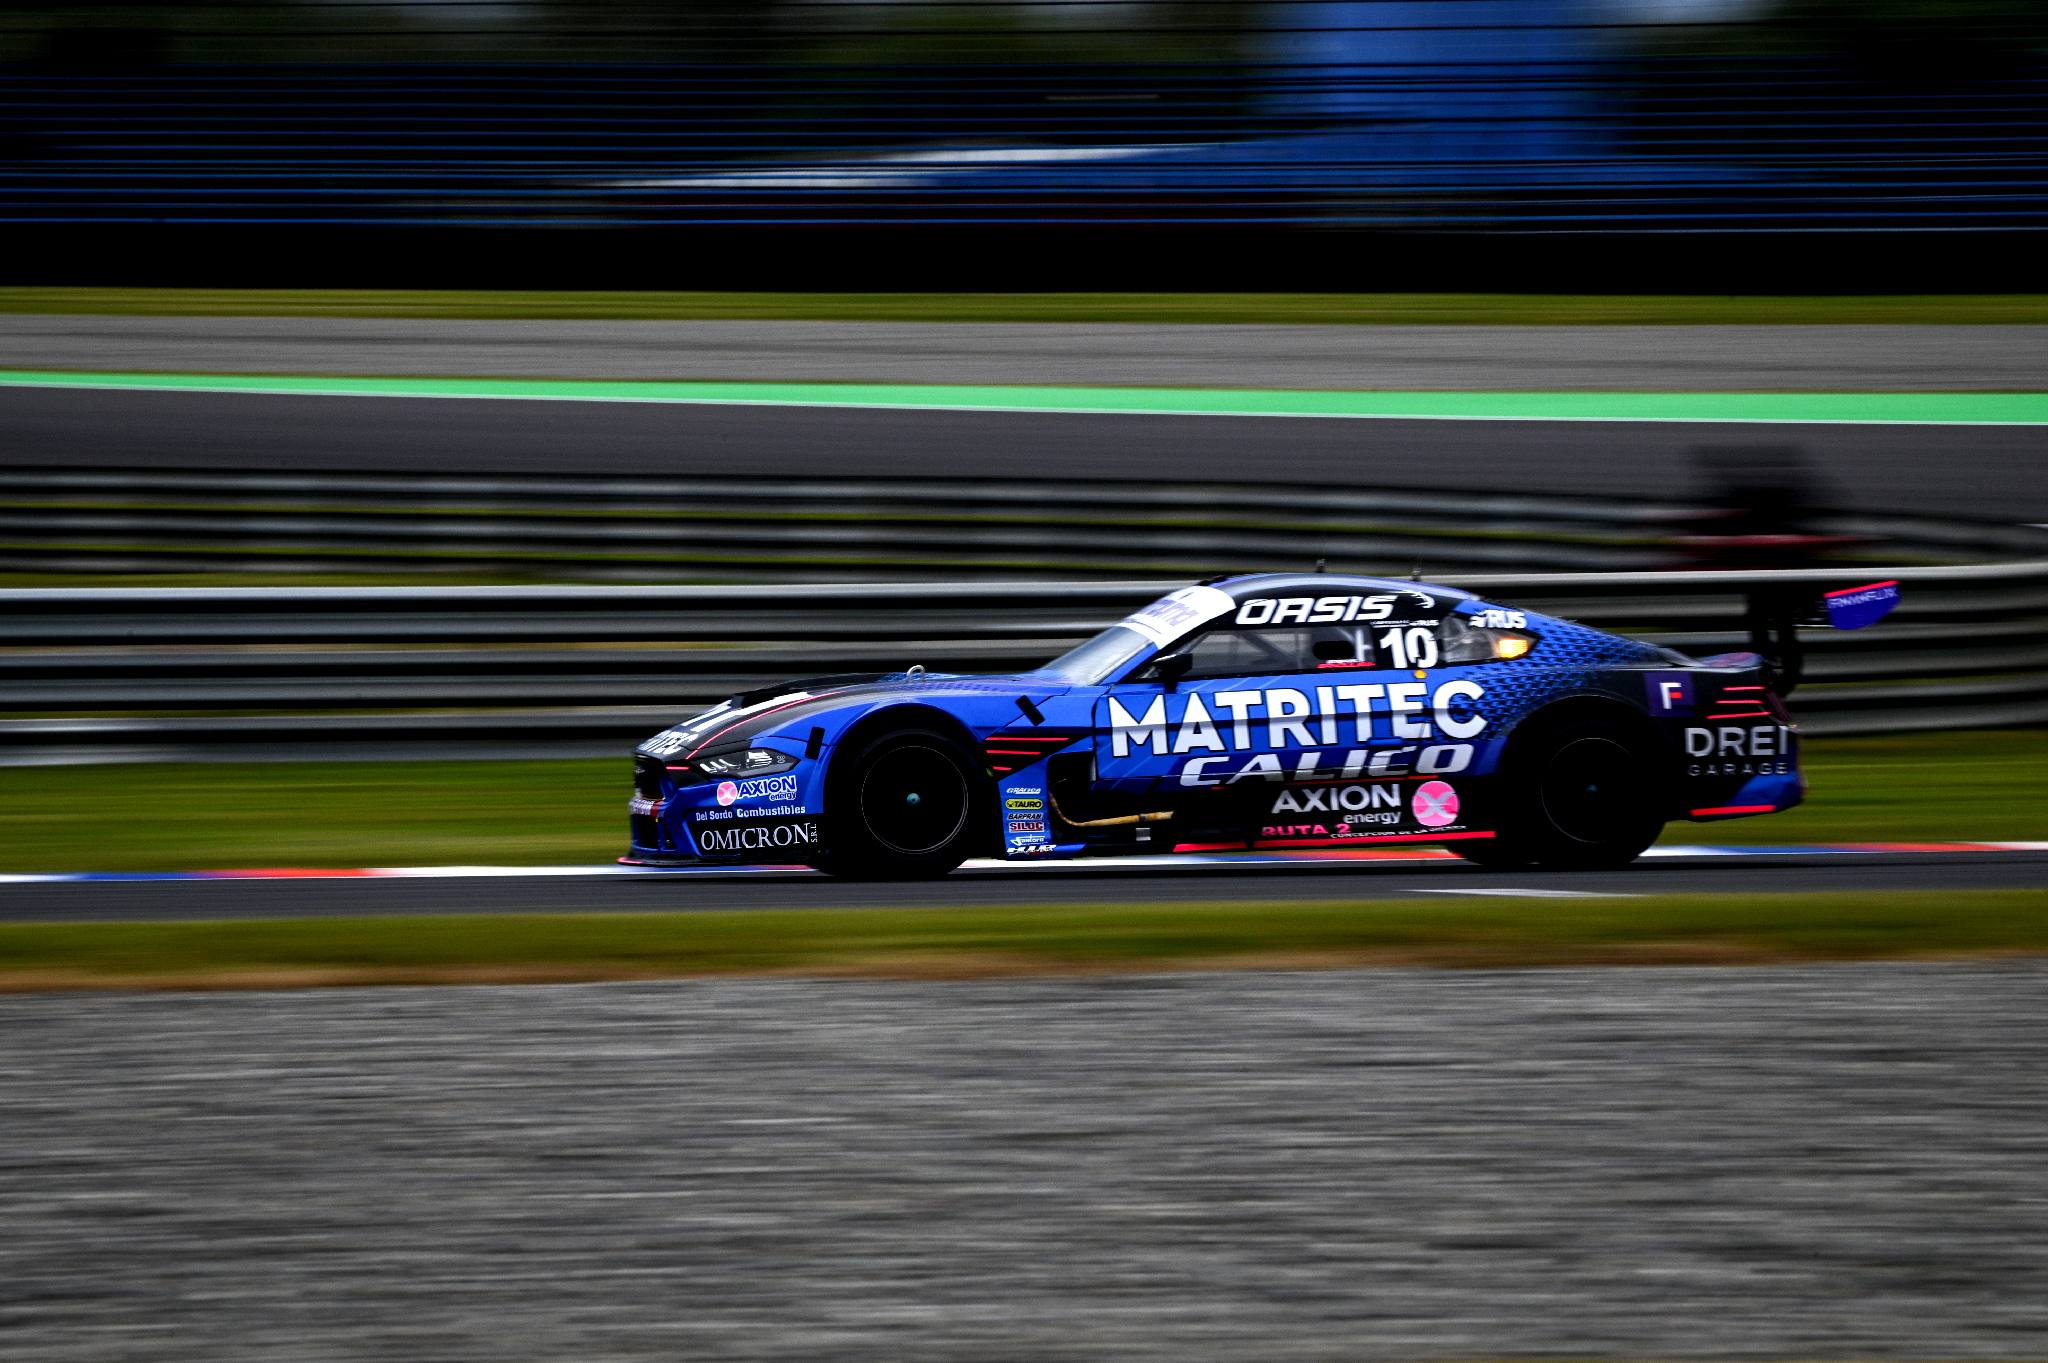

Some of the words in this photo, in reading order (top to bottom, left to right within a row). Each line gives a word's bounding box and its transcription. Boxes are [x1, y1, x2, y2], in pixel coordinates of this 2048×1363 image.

[1235, 595, 1399, 625] OASIS
[1488, 609, 1527, 628] RUS
[1380, 627, 1439, 669] 10
[1659, 682, 1683, 710] F
[1108, 680, 1488, 757] MATRITEC
[1684, 725, 1789, 757] DREI
[1179, 743, 1474, 787] CALICO
[1687, 762, 1789, 777] GARAGE
[737, 775, 797, 799] AXION
[769, 792, 797, 801] energy
[1271, 783, 1402, 814] AXION
[696, 812, 708, 821] Del
[709, 810, 733, 820] Sordo
[736, 805, 806, 818] Combustibles
[1015, 800, 1042, 808] TAURO
[1261, 824, 1329, 836] RUTA
[1335, 823, 1351, 833] 2
[1343, 811, 1402, 825] energy
[701, 822, 811, 850] OMICRON
